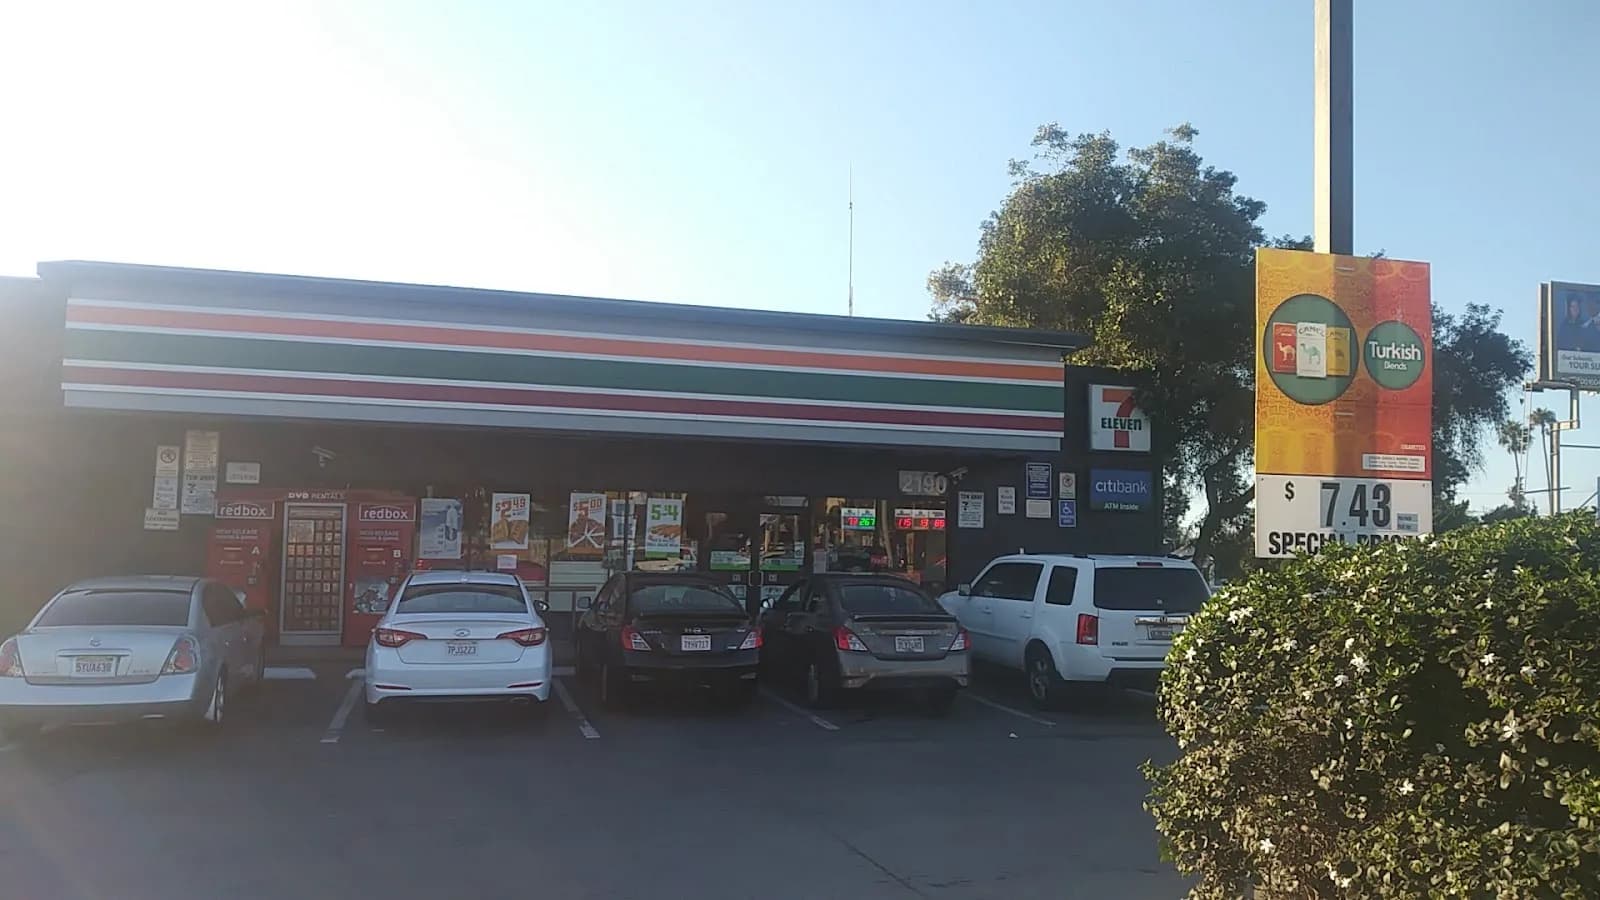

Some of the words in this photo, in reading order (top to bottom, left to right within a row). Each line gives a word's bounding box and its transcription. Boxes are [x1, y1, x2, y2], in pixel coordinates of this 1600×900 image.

[1368, 341, 1421, 360] Turkish
[1384, 360, 1407, 370] Blends
[1568, 361, 1589, 369] YOUR
[1102, 388, 1136, 449] 7
[1095, 479, 1147, 494] citibank
[1104, 502, 1118, 510] ATM
[1284, 480, 1295, 502] $
[1321, 482, 1391, 527] 7.43
[219, 504, 267, 517] redbox
[363, 508, 409, 519] redbox
[252, 546, 260, 554] A
[393, 549, 401, 557] B
